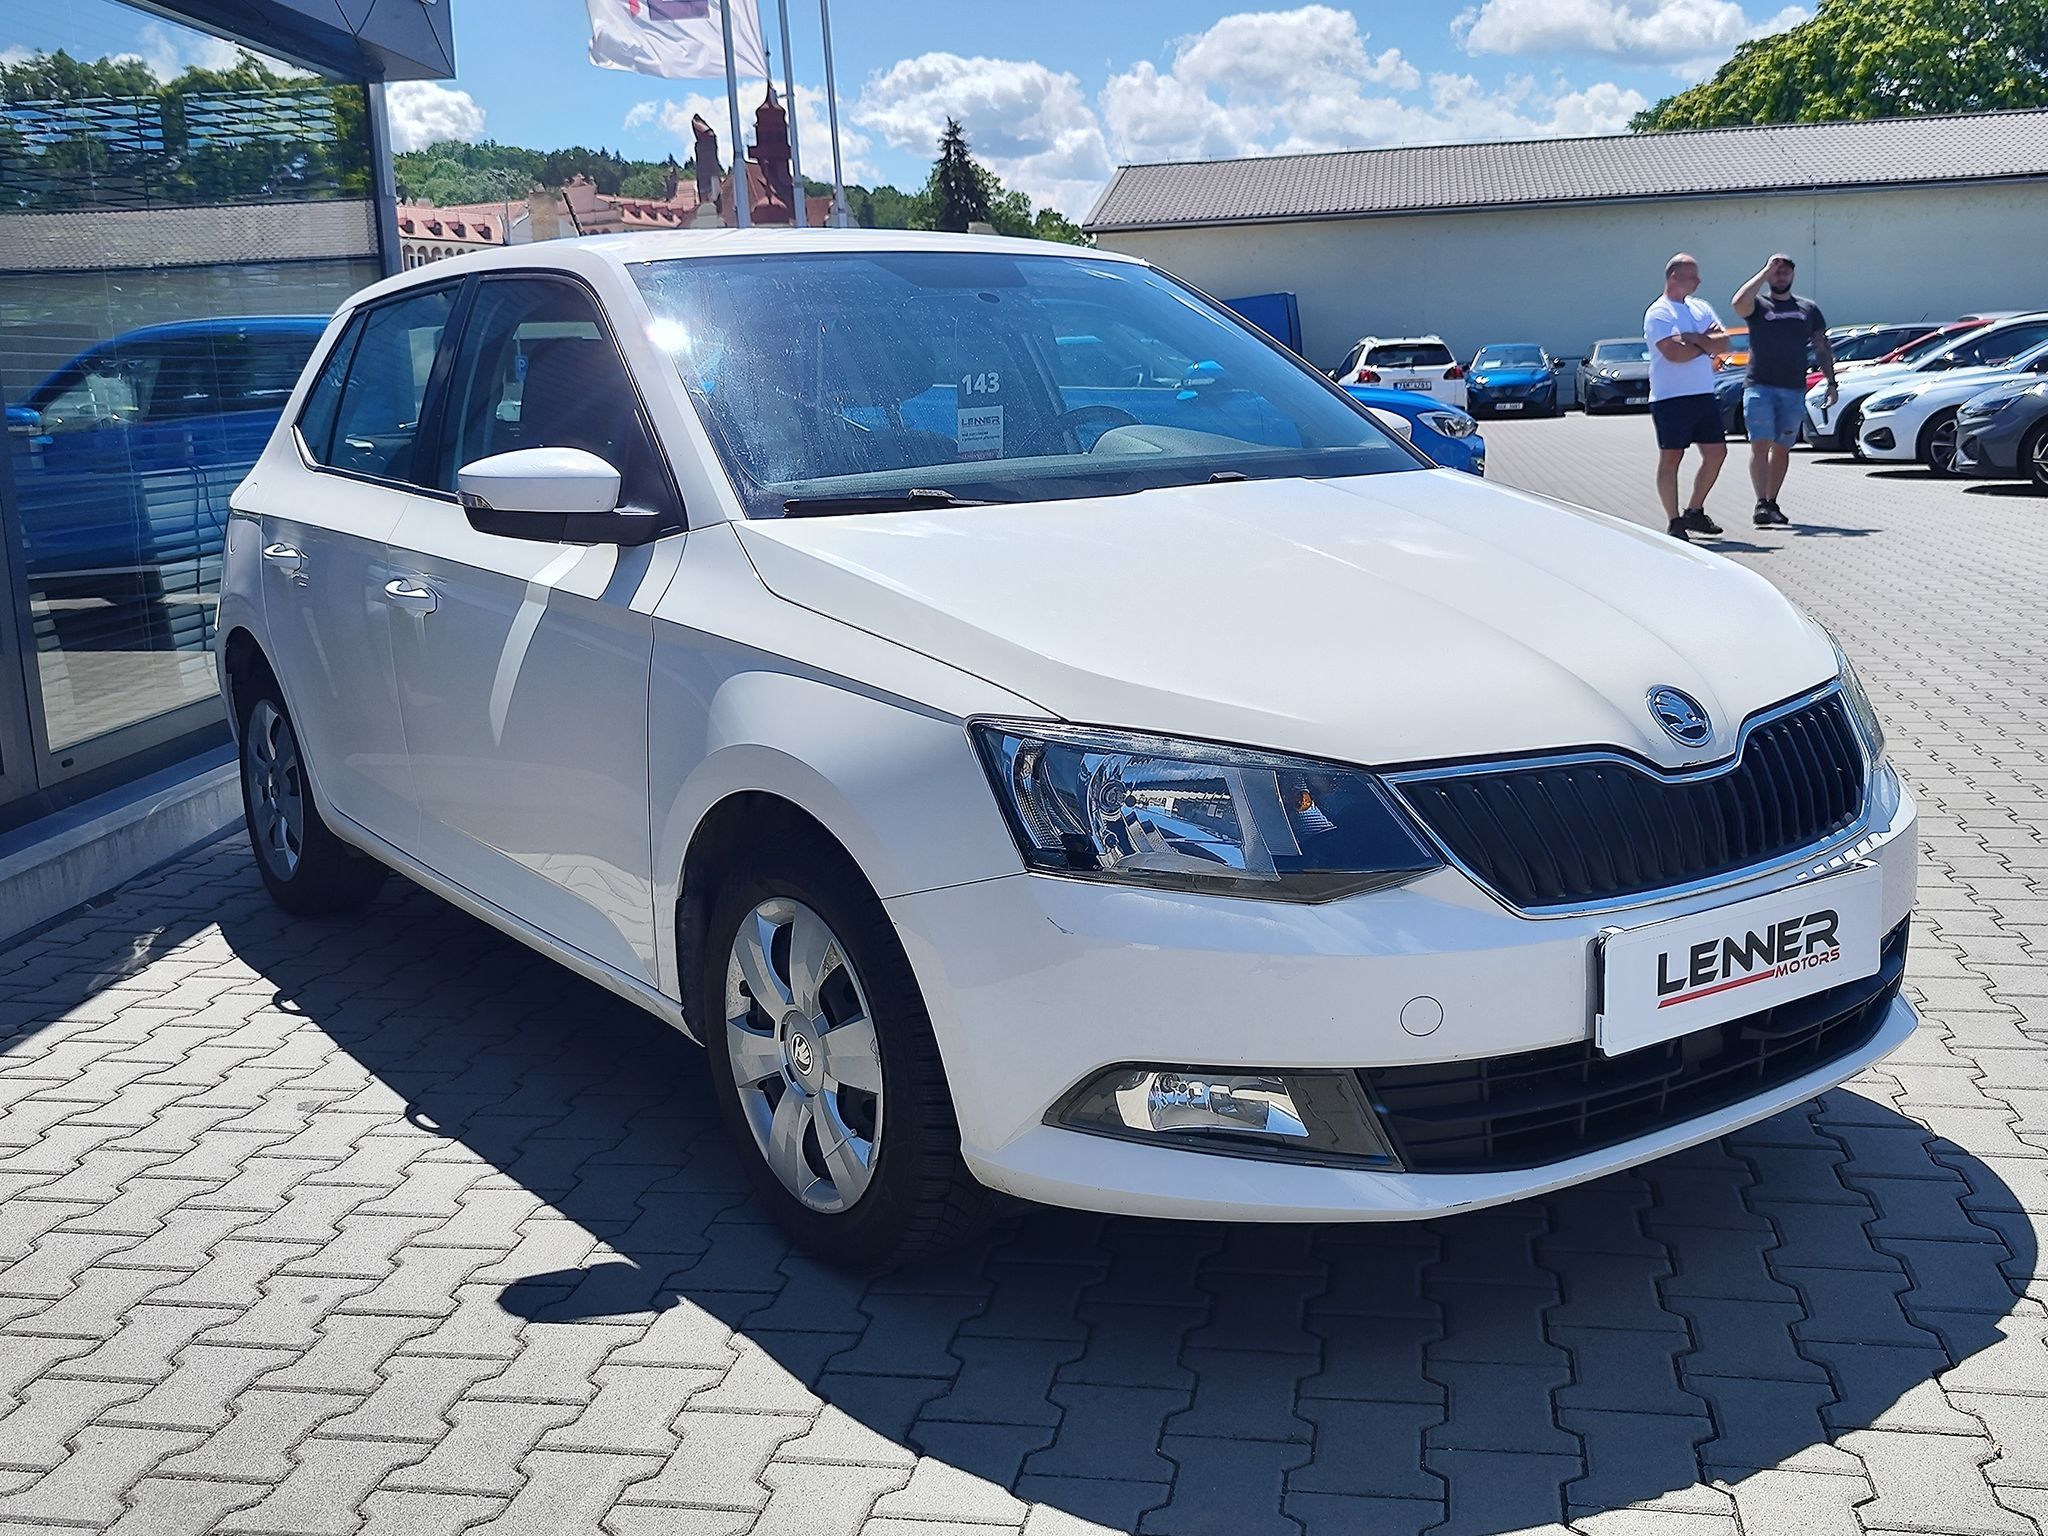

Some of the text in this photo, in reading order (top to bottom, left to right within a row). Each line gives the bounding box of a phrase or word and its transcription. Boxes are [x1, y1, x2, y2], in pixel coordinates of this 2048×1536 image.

[961, 372, 1000, 395] 143
[961, 415, 1001, 426] LENNER
[1657, 909, 1841, 997] LENNER
[1774, 947, 1841, 979] MOTORS
